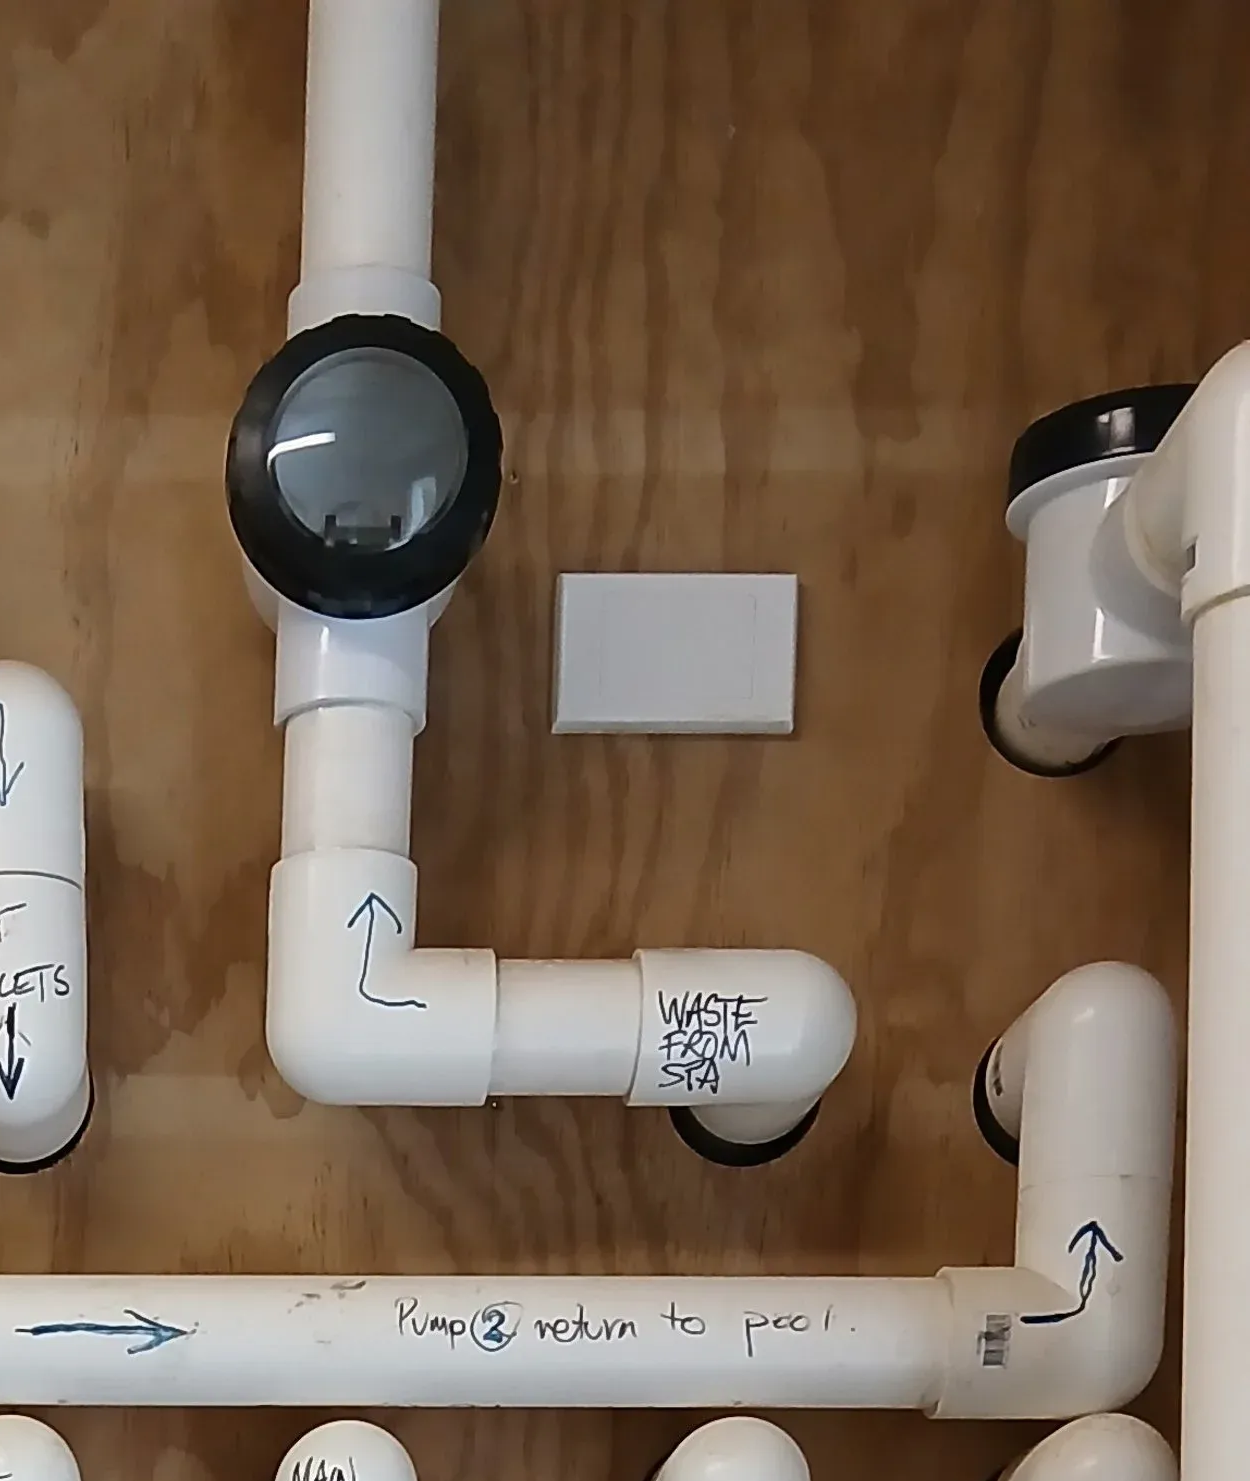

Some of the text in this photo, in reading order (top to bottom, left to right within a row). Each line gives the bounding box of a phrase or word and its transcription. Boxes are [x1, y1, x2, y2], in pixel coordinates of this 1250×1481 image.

[658, 990, 768, 1033] WASTE
[658, 1029, 750, 1066] FROM
[533, 1303, 638, 1343] return
[660, 1301, 706, 1336] to
